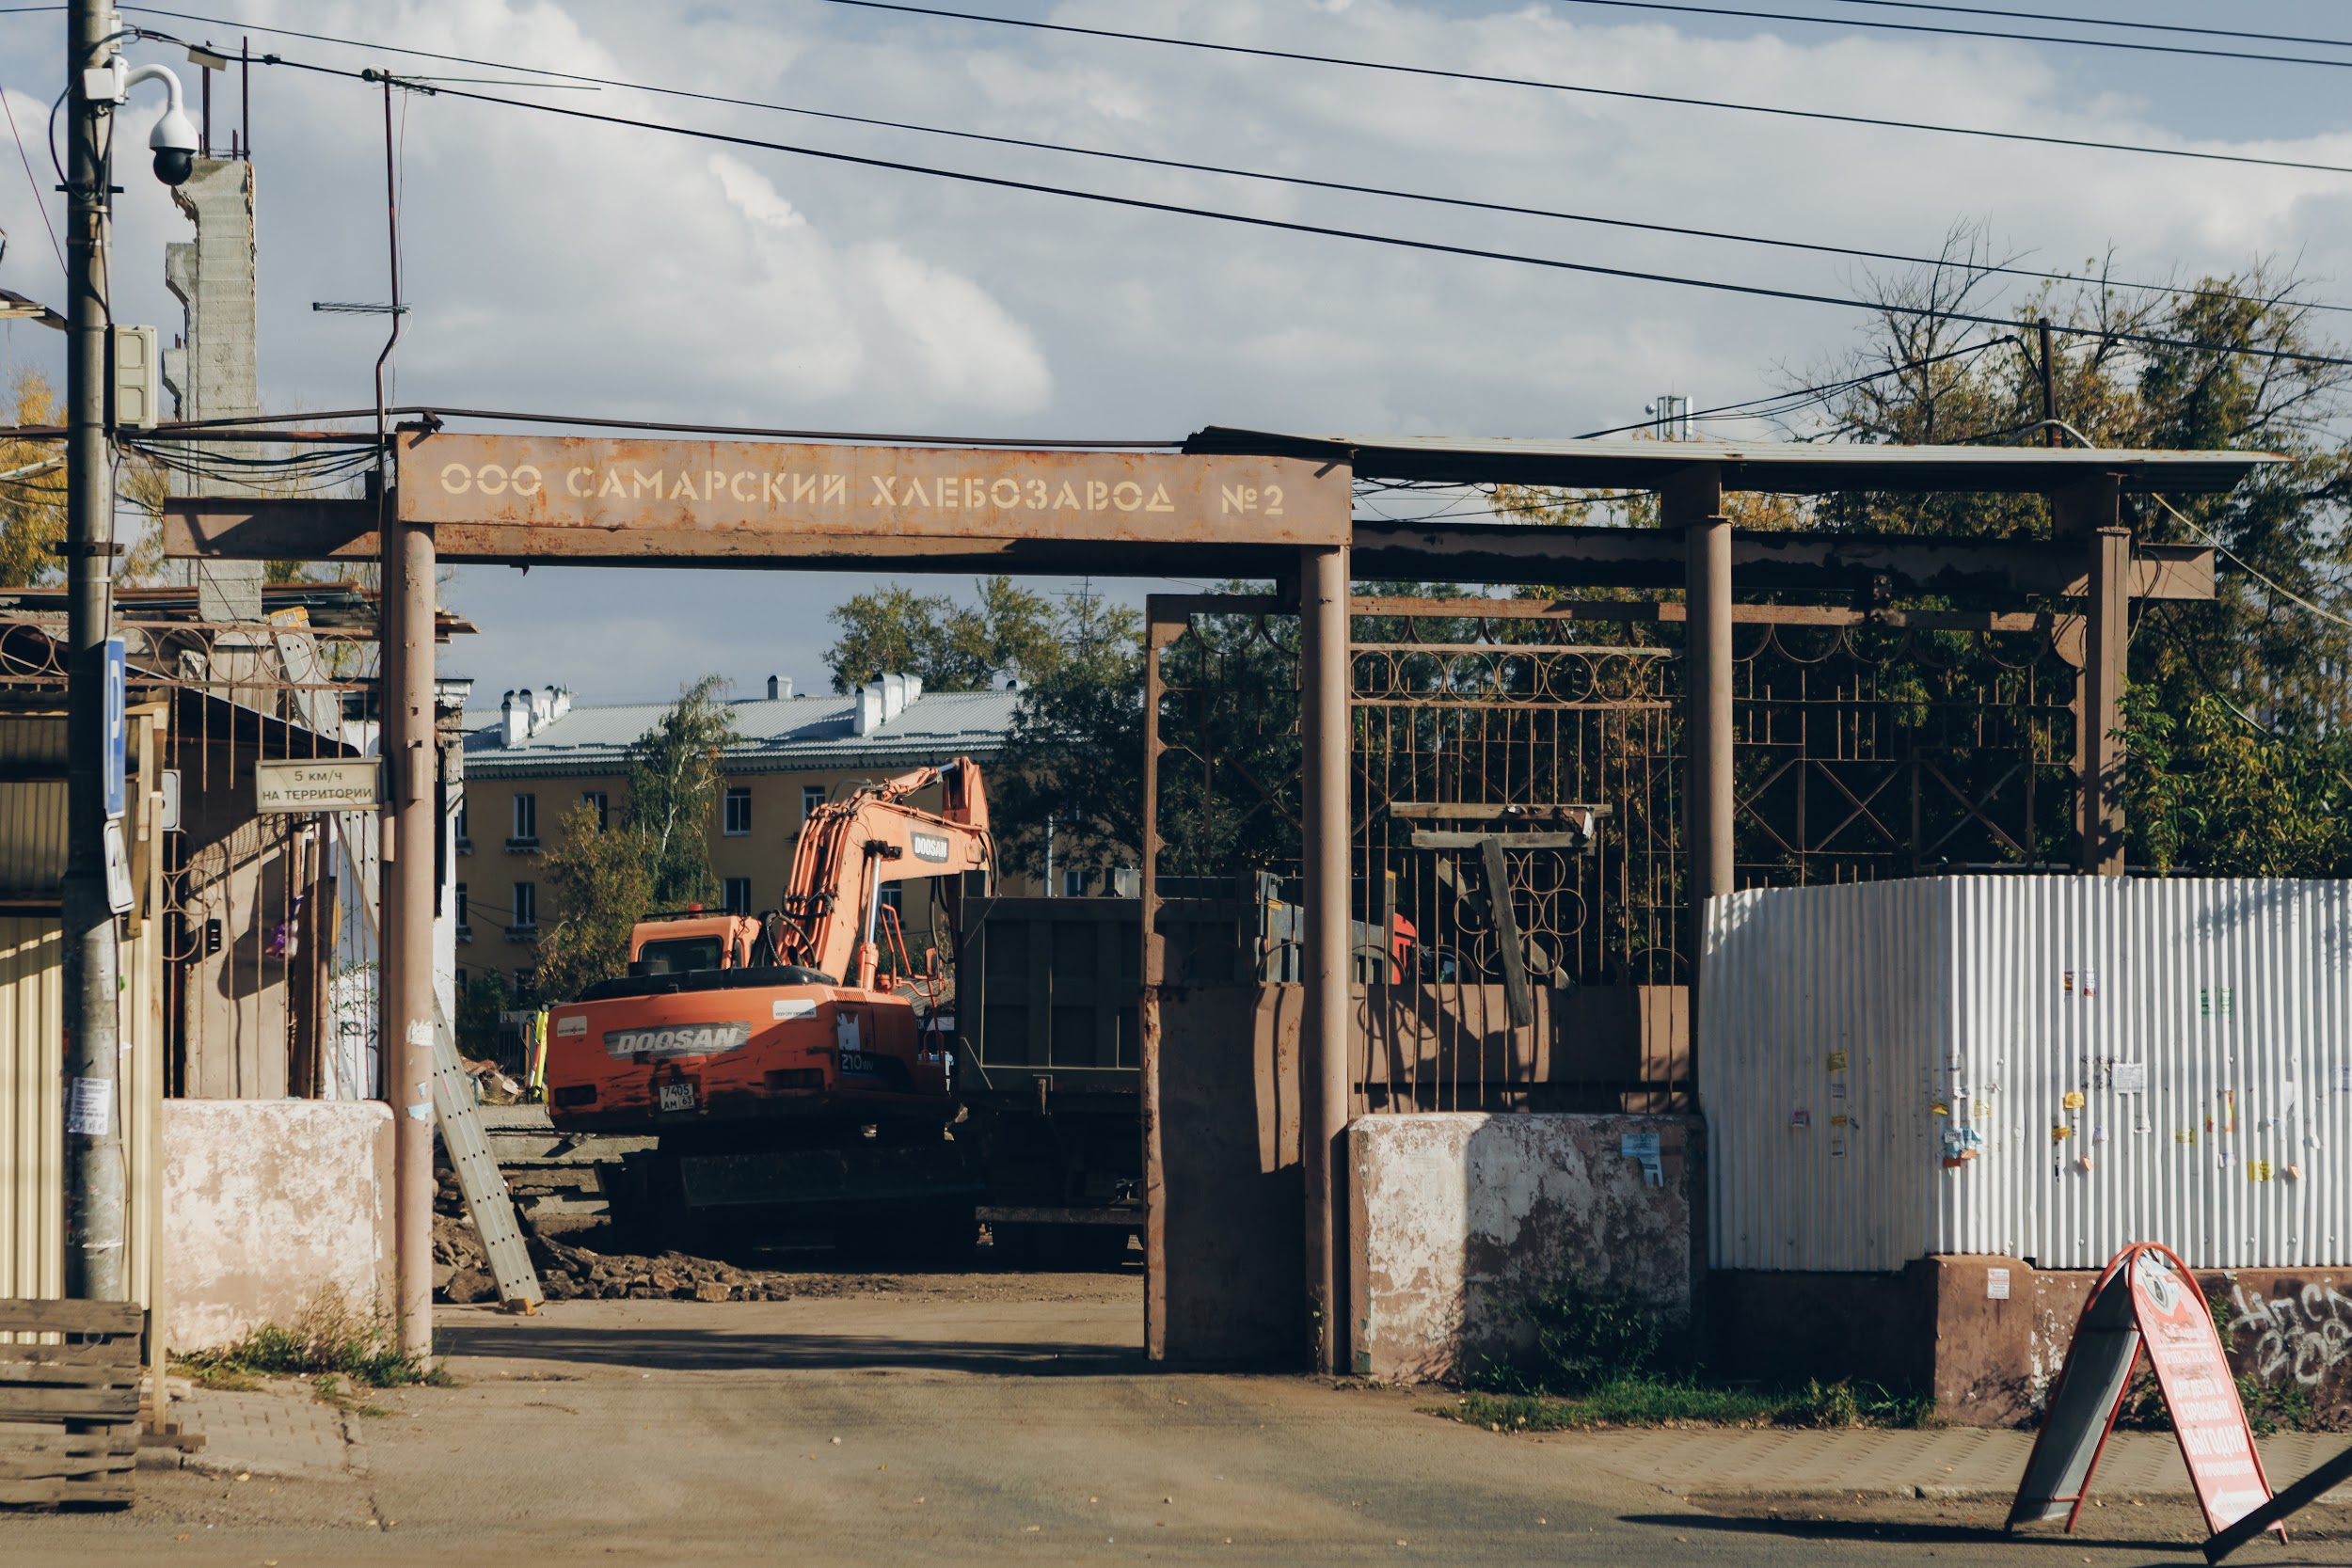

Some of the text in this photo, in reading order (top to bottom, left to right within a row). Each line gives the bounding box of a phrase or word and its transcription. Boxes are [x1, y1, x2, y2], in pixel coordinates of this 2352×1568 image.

[440, 463, 542, 496] ООО
[566, 467, 846, 505] САМАРСКИЙ
[871, 475, 1175, 513] ХЛЕБОЗАВОД
[294, 770, 303, 782] 5
[263, 788, 373, 801] НА ТЕРРИТОРИИ
[914, 836, 947, 858] DOOSAN
[616, 1027, 739, 1053] DOOSAN
[663, 1085, 690, 1098] 7405
[682, 1095, 692, 1105] 63
[2214, 1377, 2224, 1395] И
[2178, 1400, 2232, 1422] ВЗРОСЛЫХ
[2181, 1424, 2248, 1459] ВЫГОДНО
